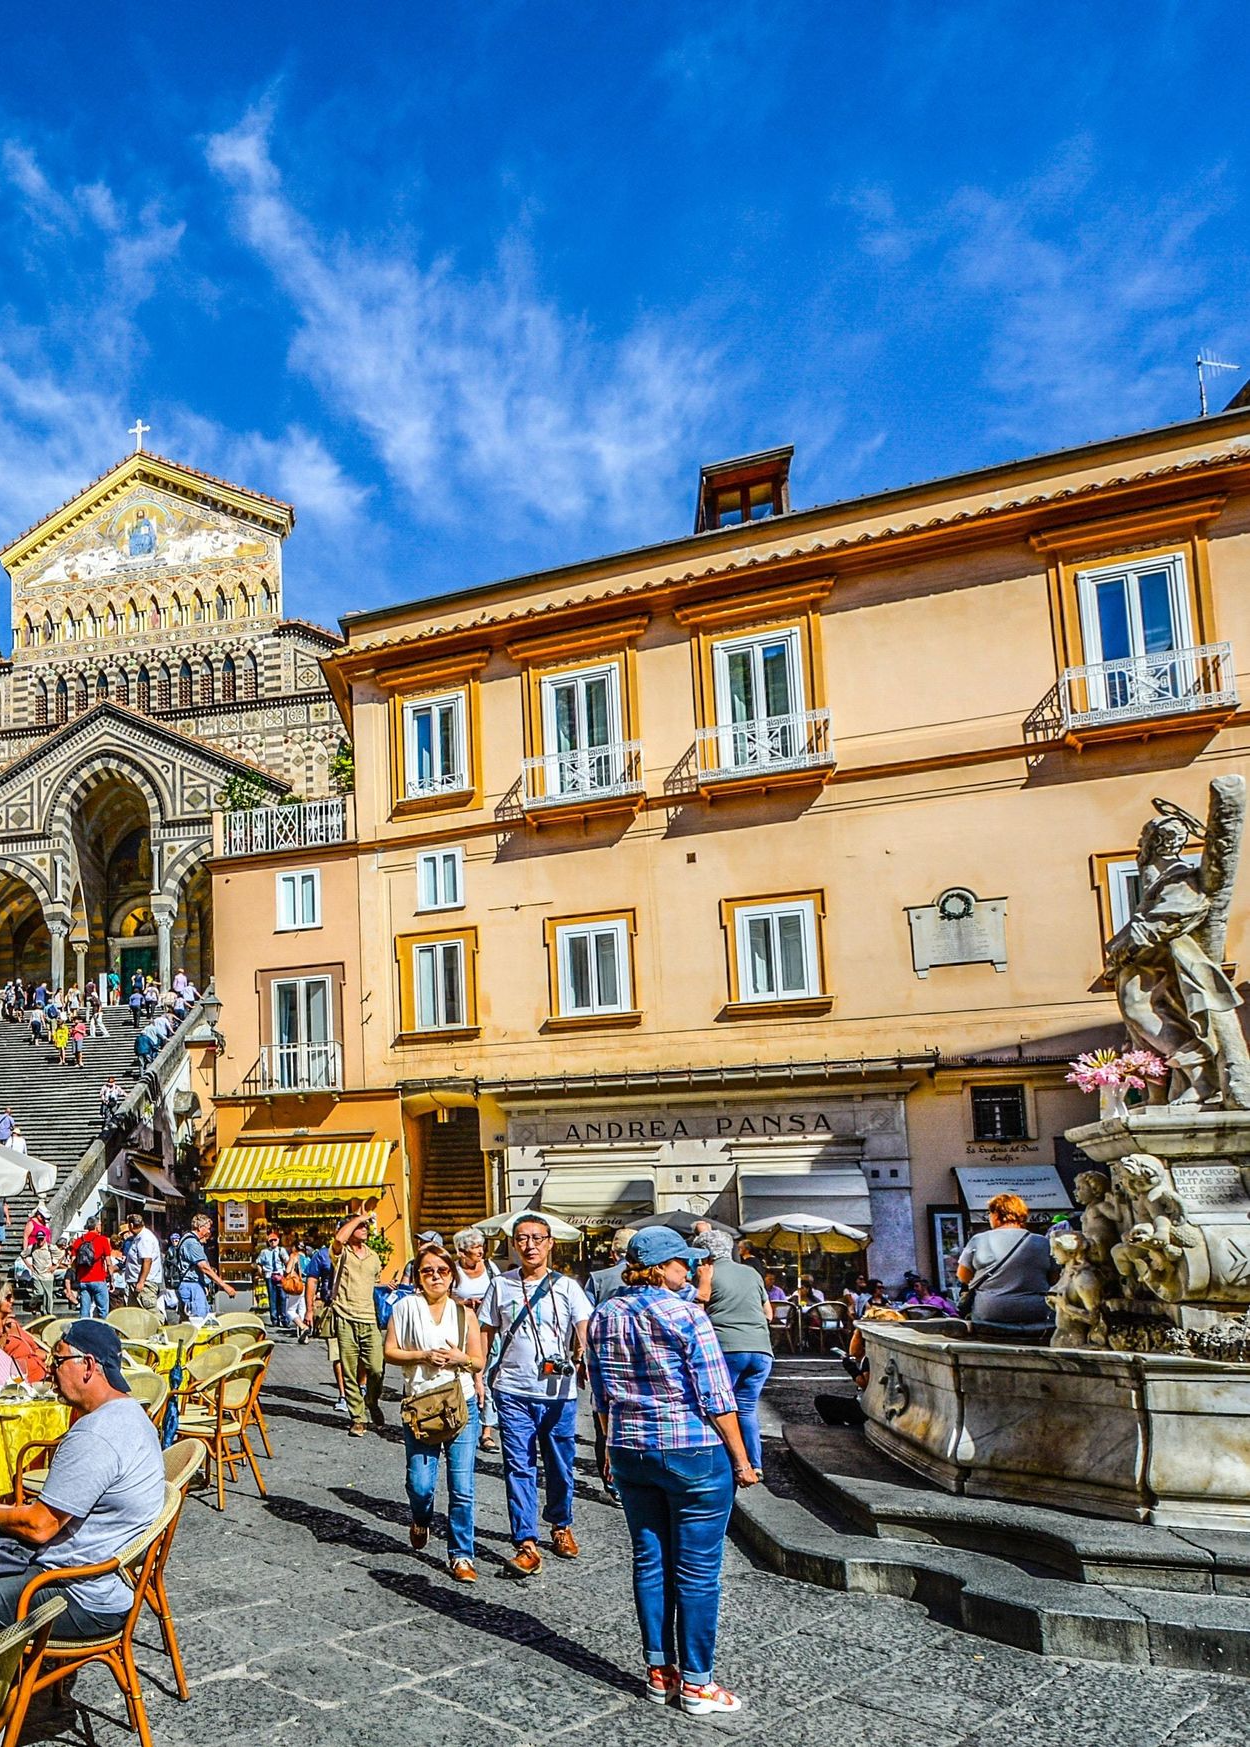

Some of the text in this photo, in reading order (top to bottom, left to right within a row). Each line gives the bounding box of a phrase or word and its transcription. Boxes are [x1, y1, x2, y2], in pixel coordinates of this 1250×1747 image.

[566, 1113, 832, 1140] ANDREA PANSA
[565, 1215, 623, 1225] Pasticceria
